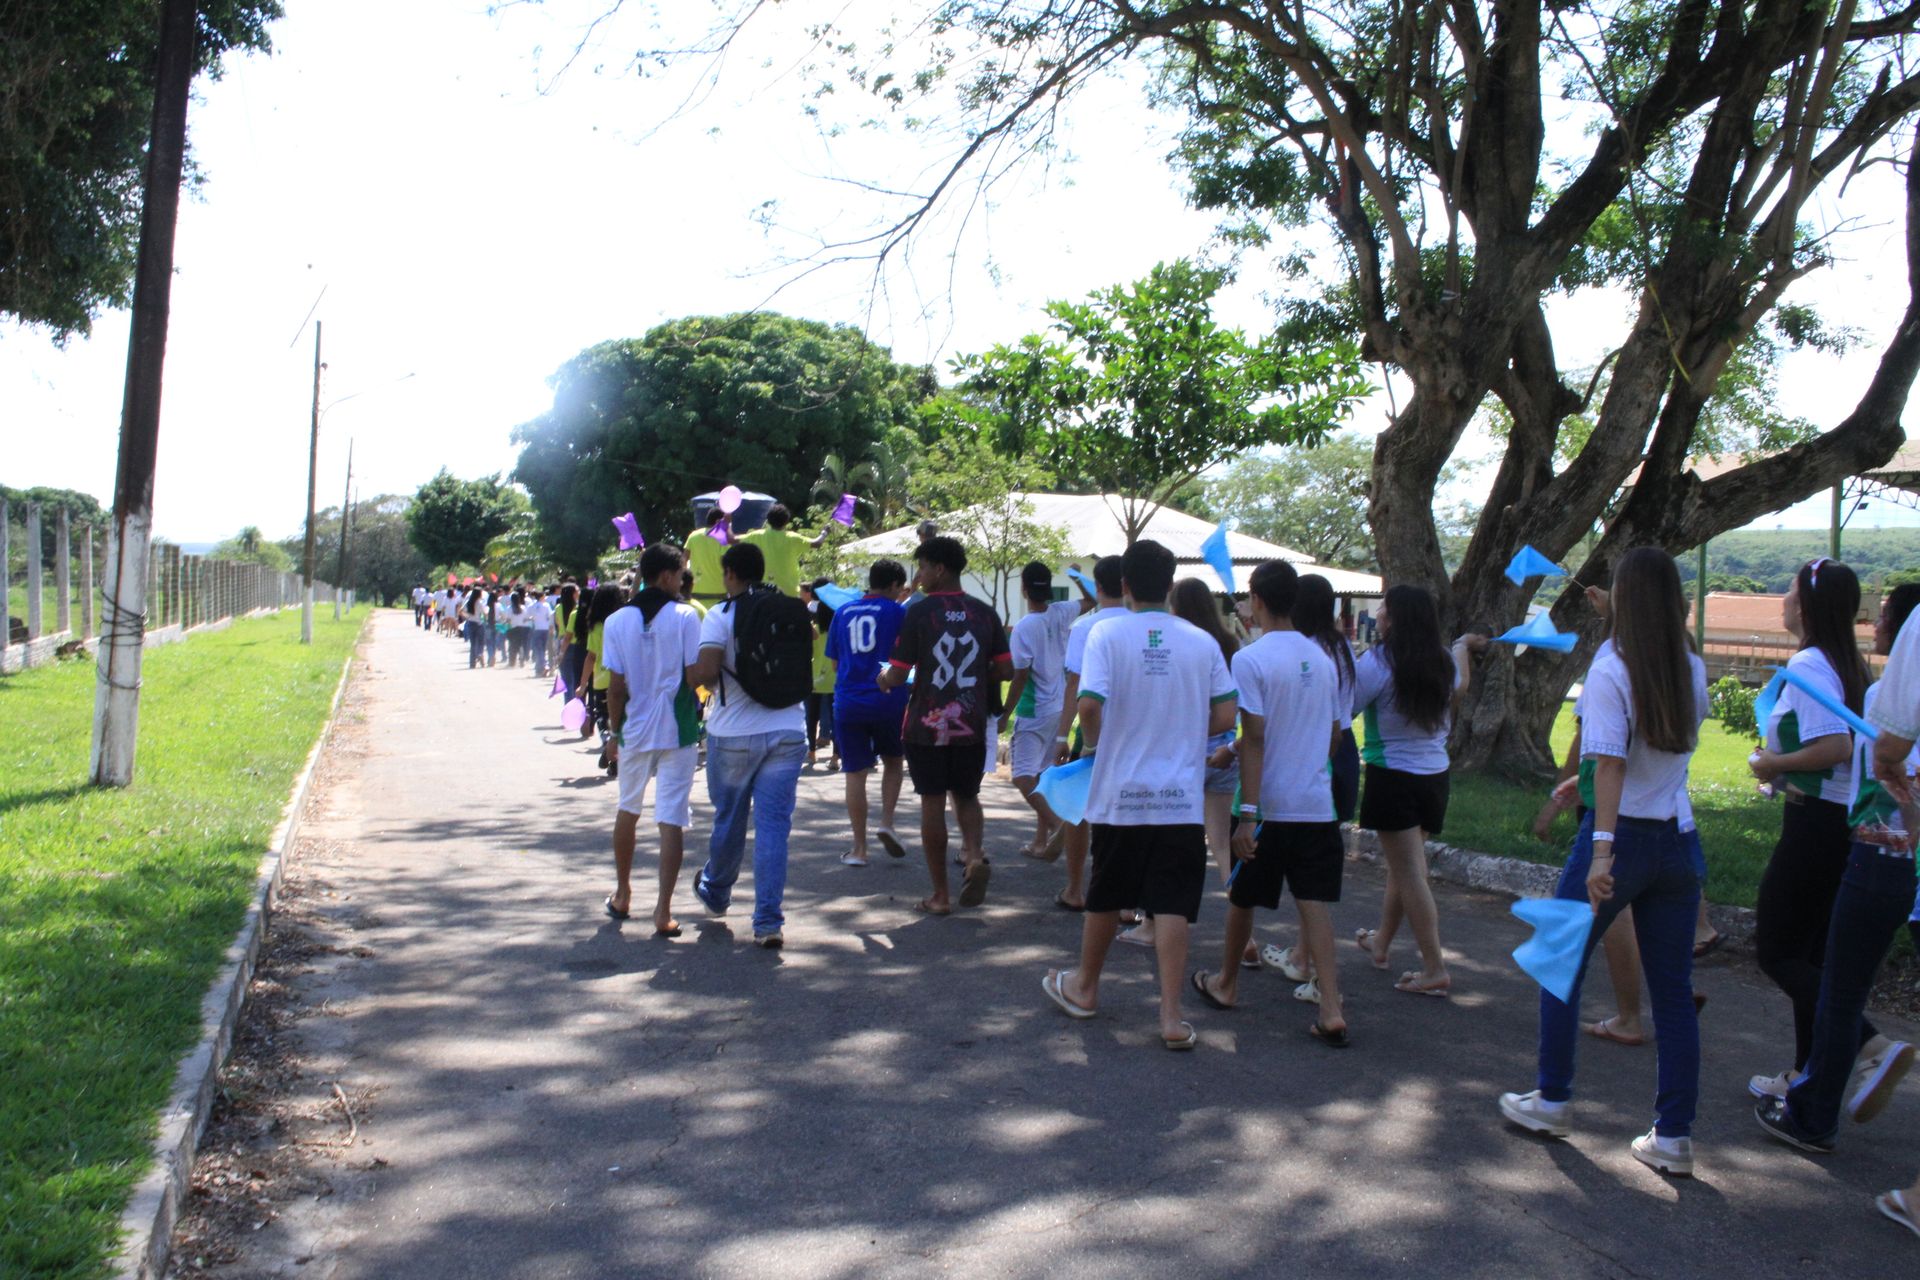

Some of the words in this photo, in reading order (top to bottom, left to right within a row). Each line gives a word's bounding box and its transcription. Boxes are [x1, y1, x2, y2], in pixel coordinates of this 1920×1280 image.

[847, 615, 877, 654] 10
[931, 631, 980, 690] 82
[1120, 789, 1155, 799] Desde
[1159, 788, 1185, 798] 1943
